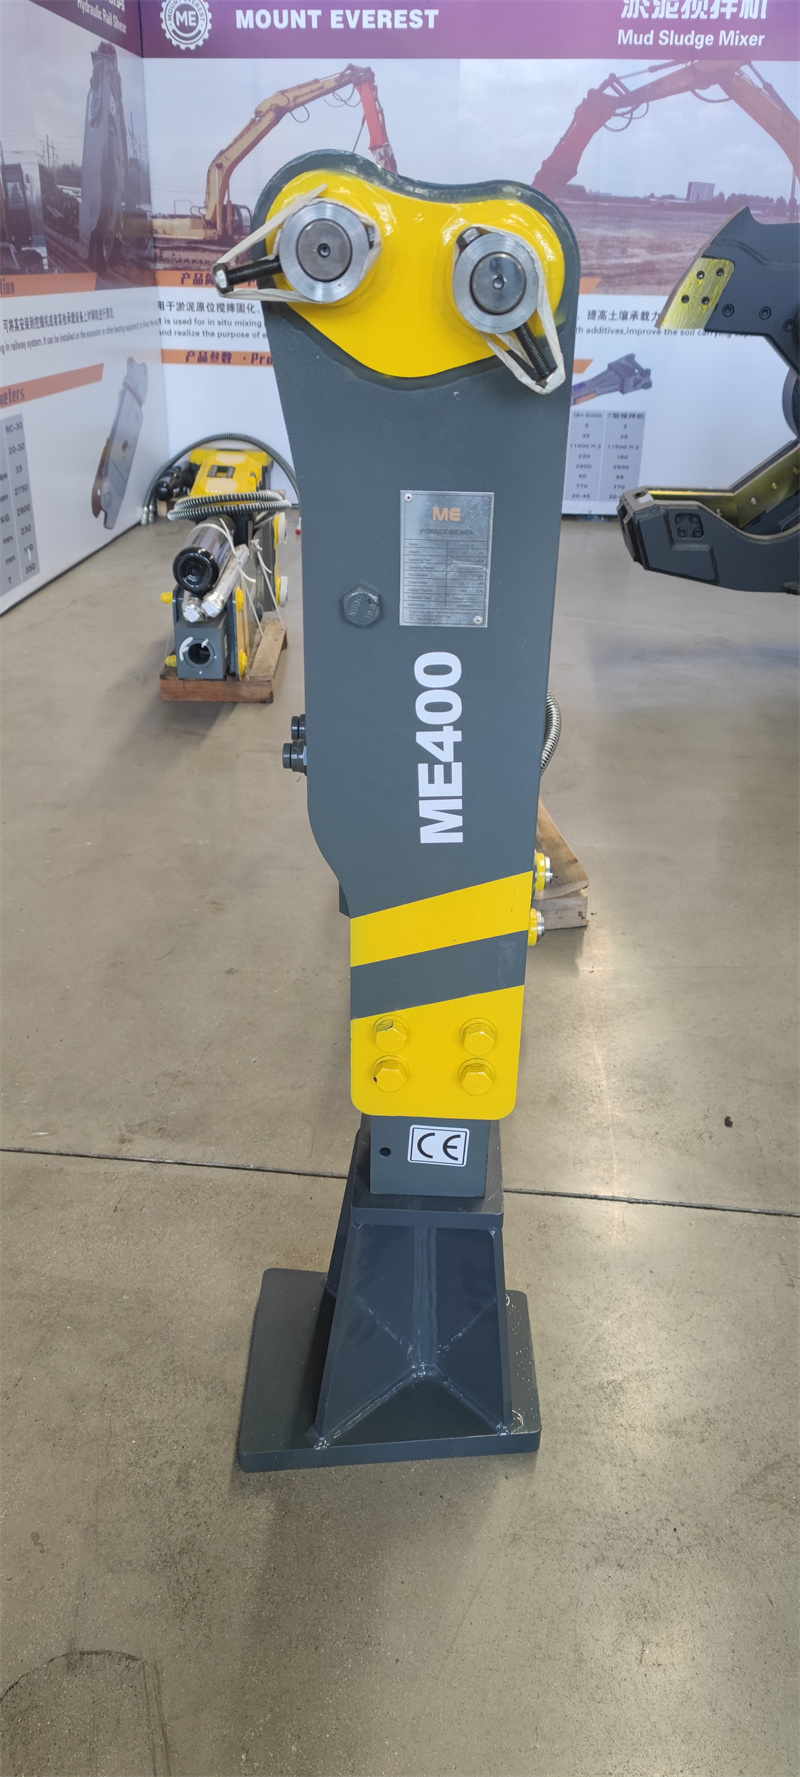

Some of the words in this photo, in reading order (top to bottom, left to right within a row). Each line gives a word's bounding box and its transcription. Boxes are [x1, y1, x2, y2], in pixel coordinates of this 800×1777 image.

[103, 8, 113, 26] Rail
[176, 11, 197, 27] ME
[235, 9, 322, 29] MOUNT
[330, 9, 439, 29] EVEREST
[617, 29, 654, 46] Mud
[658, 29, 714, 50] Sludge
[719, 30, 765, 46] Mixer
[164, 317, 171, 325] is
[173, 318, 192, 326] used
[194, 318, 205, 326] for
[207, 318, 215, 326] in
[217, 318, 232, 327] situ
[234, 319, 262, 329] mixing
[174, 329, 200, 337] realize
[202, 329, 215, 337] the
[217, 331, 250, 339] purpose
[252, 330, 260, 339] of
[680, 329, 695, 337] soil
[251, 352, 273, 365] Pro
[432, 507, 461, 521] ME
[414, 651, 463, 844] ME400
[417, 1132, 461, 1161] CE
